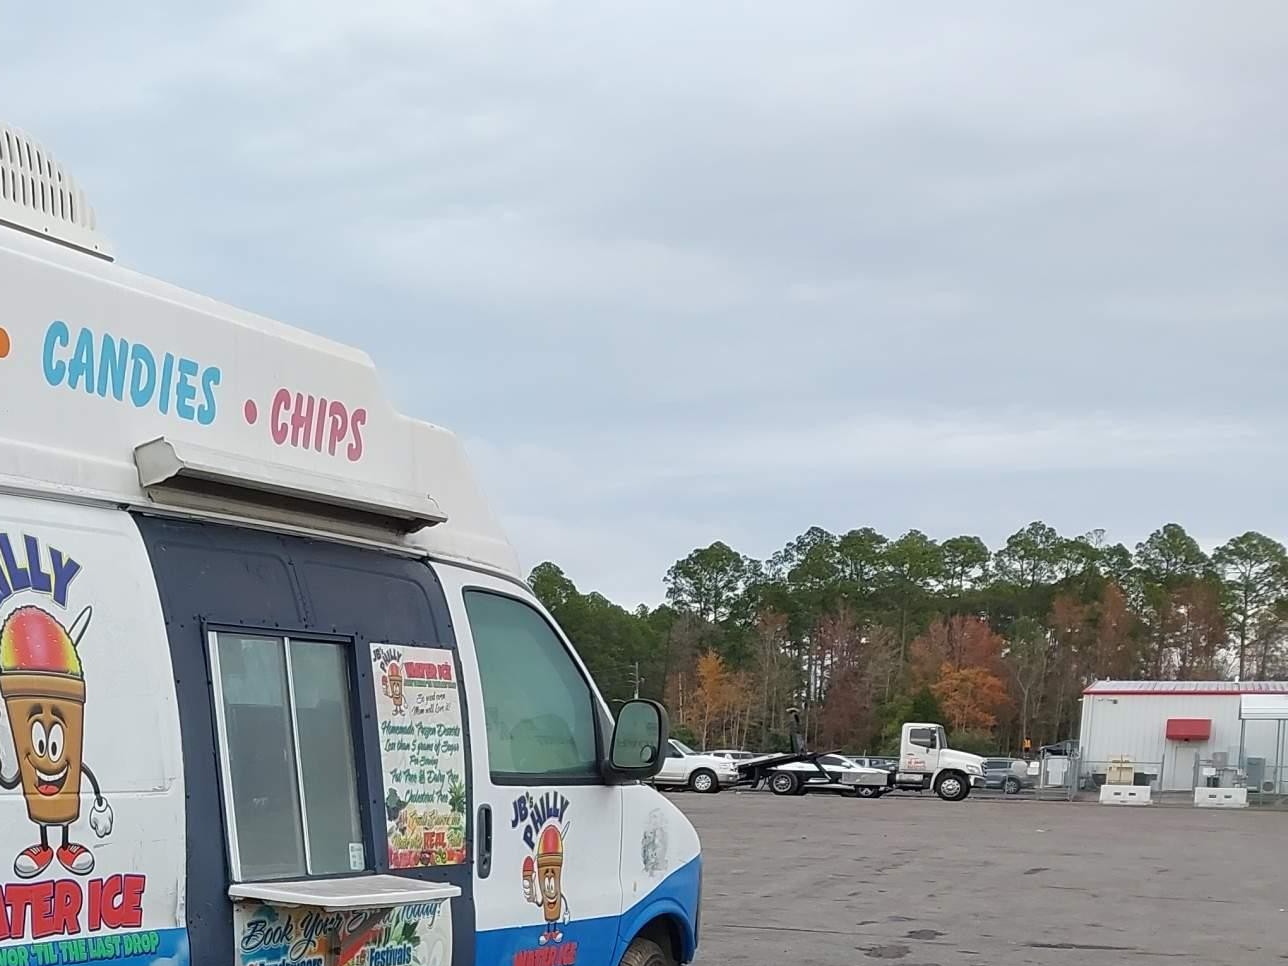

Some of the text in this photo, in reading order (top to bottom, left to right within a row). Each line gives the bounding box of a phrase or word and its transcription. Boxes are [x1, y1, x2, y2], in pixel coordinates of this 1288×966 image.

[42, 319, 222, 426] CANDIES
[269, 387, 367, 463] CHIPS
[511, 791, 534, 829] JB's
[523, 791, 570, 851] PHILLY
[86, 873, 147, 932] ICE
[59, 940, 89, 964] THE
[88, 935, 121, 960] LAST
[123, 931, 161, 956] DROP
[241, 915, 294, 951] Book
[290, 911, 344, 961] Your
